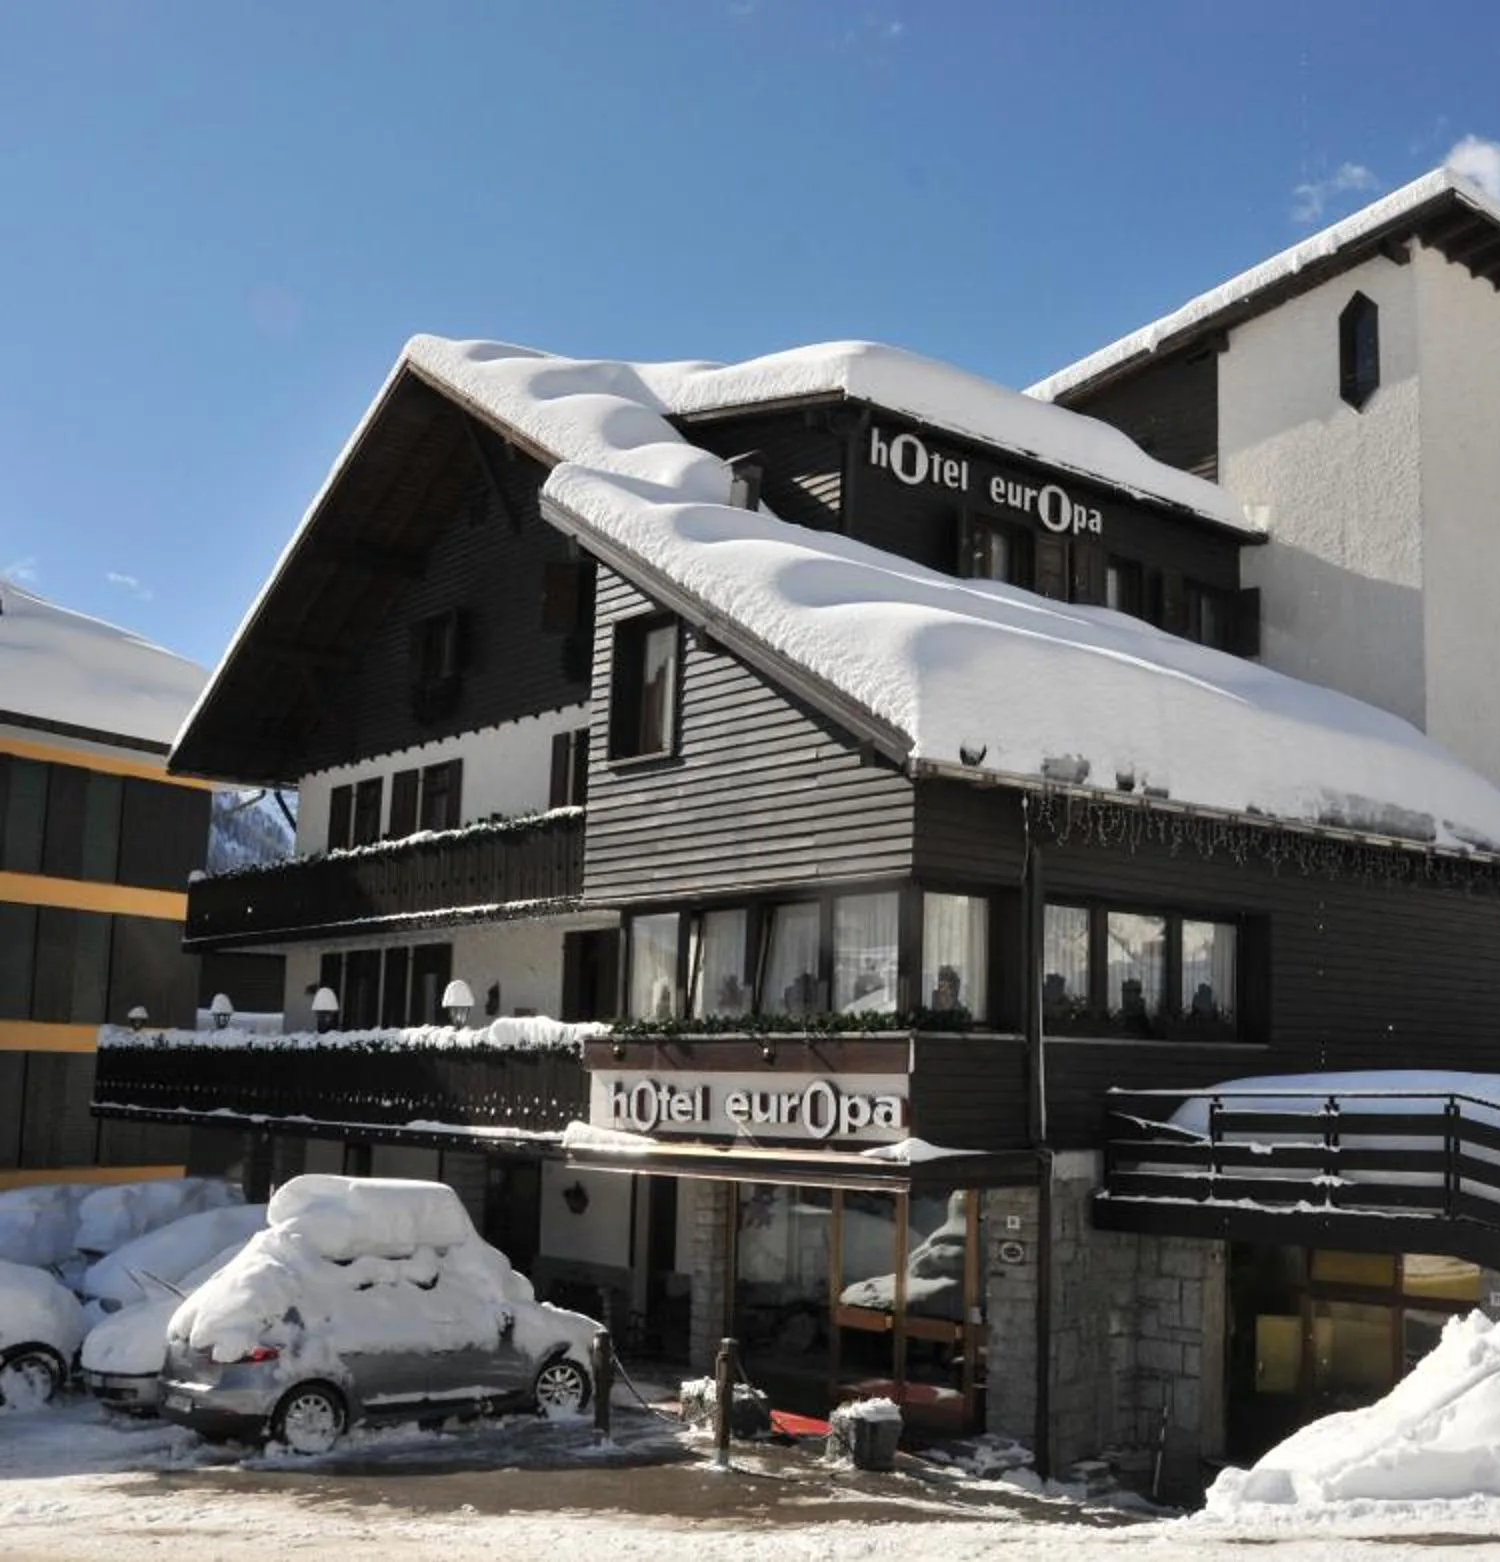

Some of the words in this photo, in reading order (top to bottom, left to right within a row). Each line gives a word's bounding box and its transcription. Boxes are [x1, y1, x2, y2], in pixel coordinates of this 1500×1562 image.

[870, 428, 969, 491] hOtel
[990, 476, 1102, 535] eurOpa
[610, 1079, 708, 1132] hOtel
[725, 1080, 904, 1139] eurOpa
